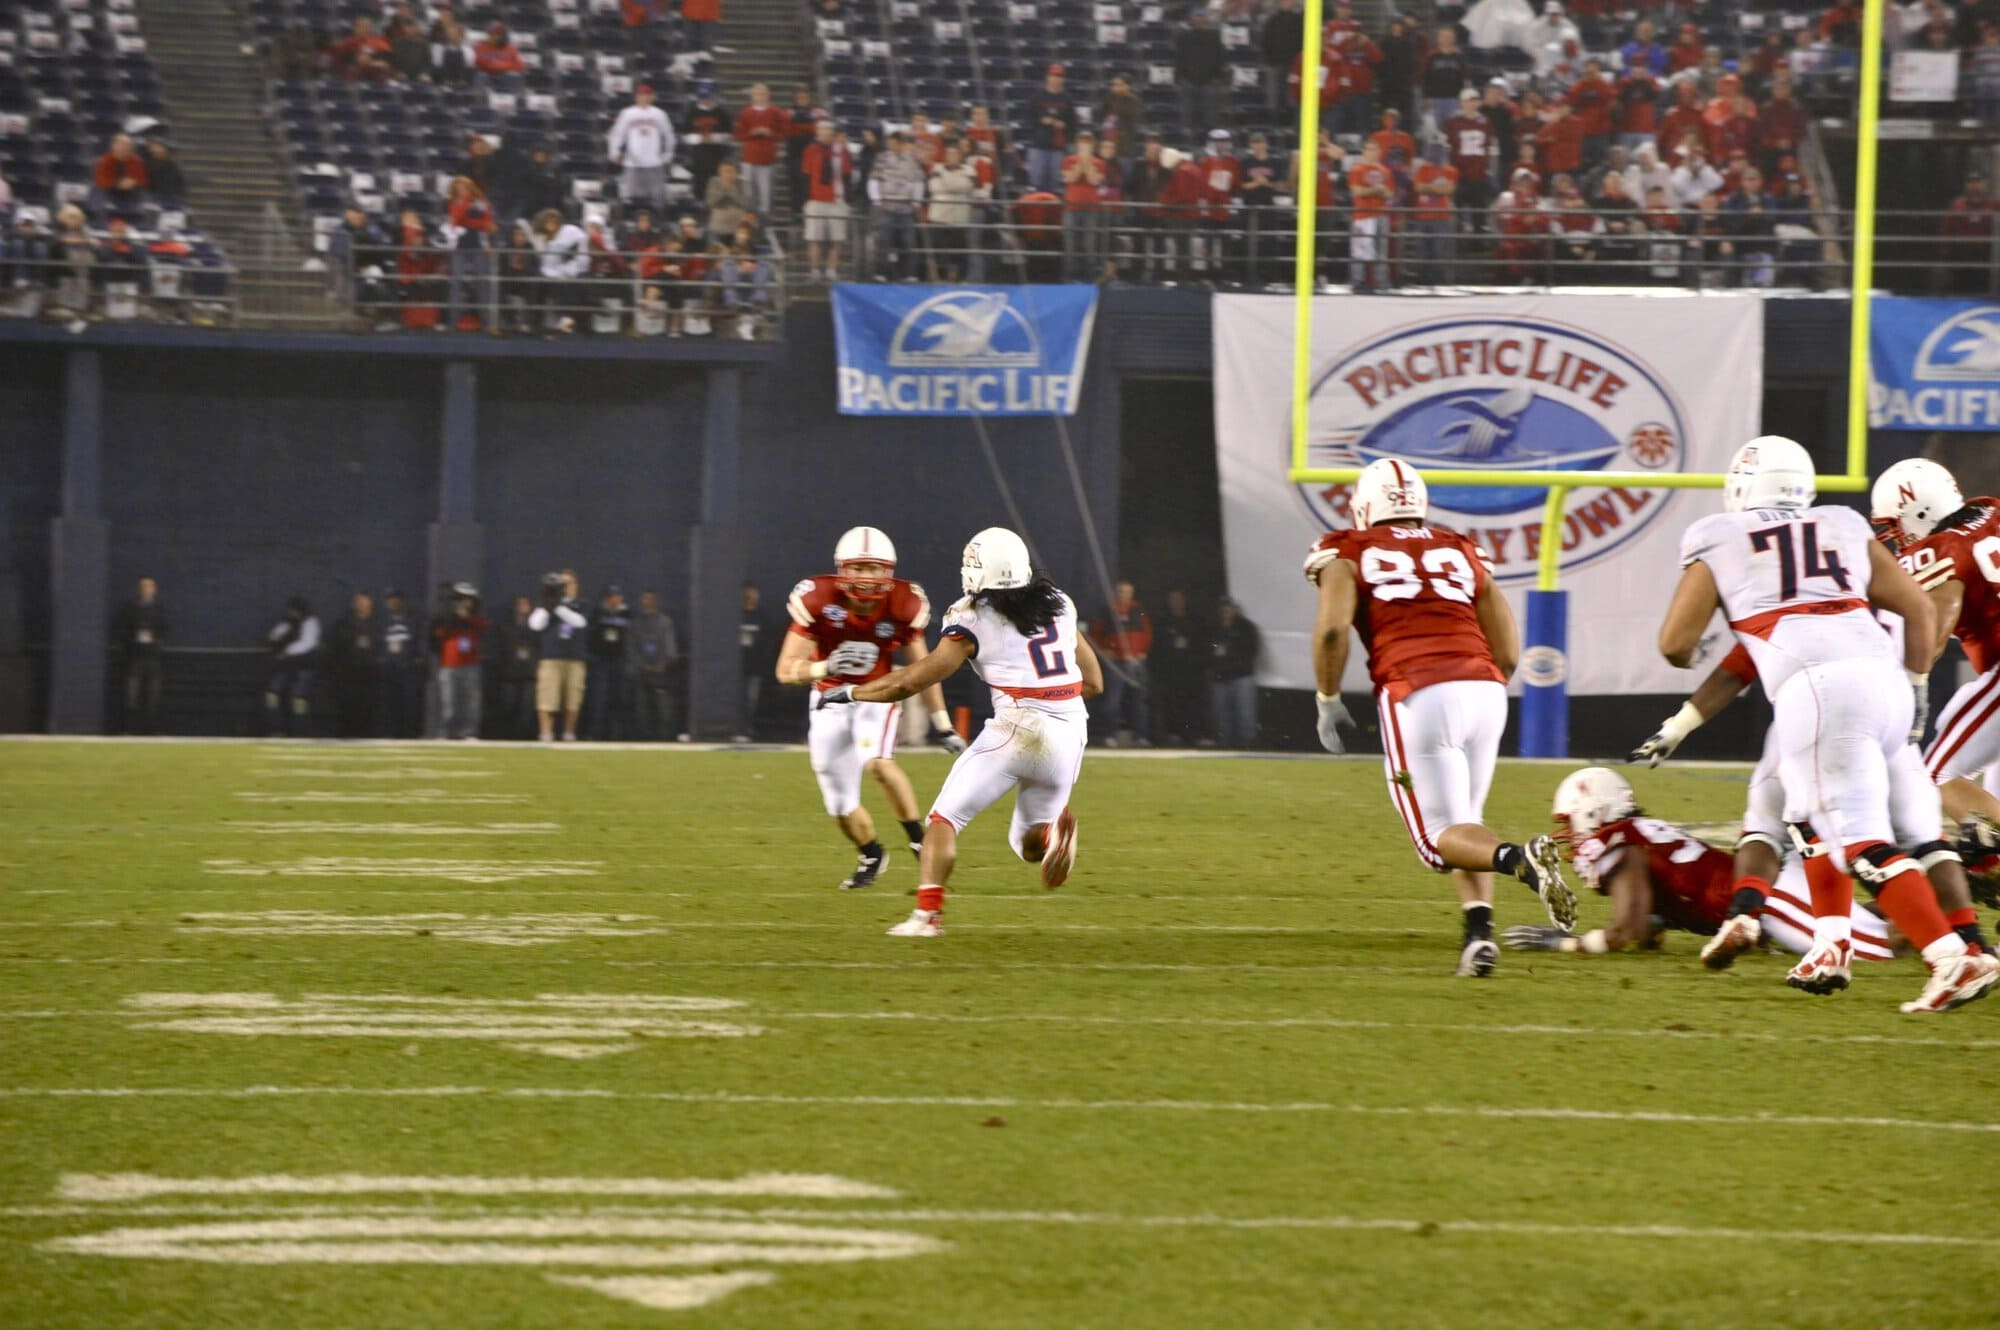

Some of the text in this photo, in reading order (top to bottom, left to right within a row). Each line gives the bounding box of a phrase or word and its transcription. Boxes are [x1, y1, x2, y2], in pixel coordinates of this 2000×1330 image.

[837, 366, 1078, 412] PACIFIC LIF
[1343, 337, 1629, 409] PACIFIC LIFE
[1361, 546, 1477, 604] 93
[1747, 521, 1853, 602] 74
[1027, 617, 1069, 679] 2
[1042, 687, 1076, 699] ARIZONA
